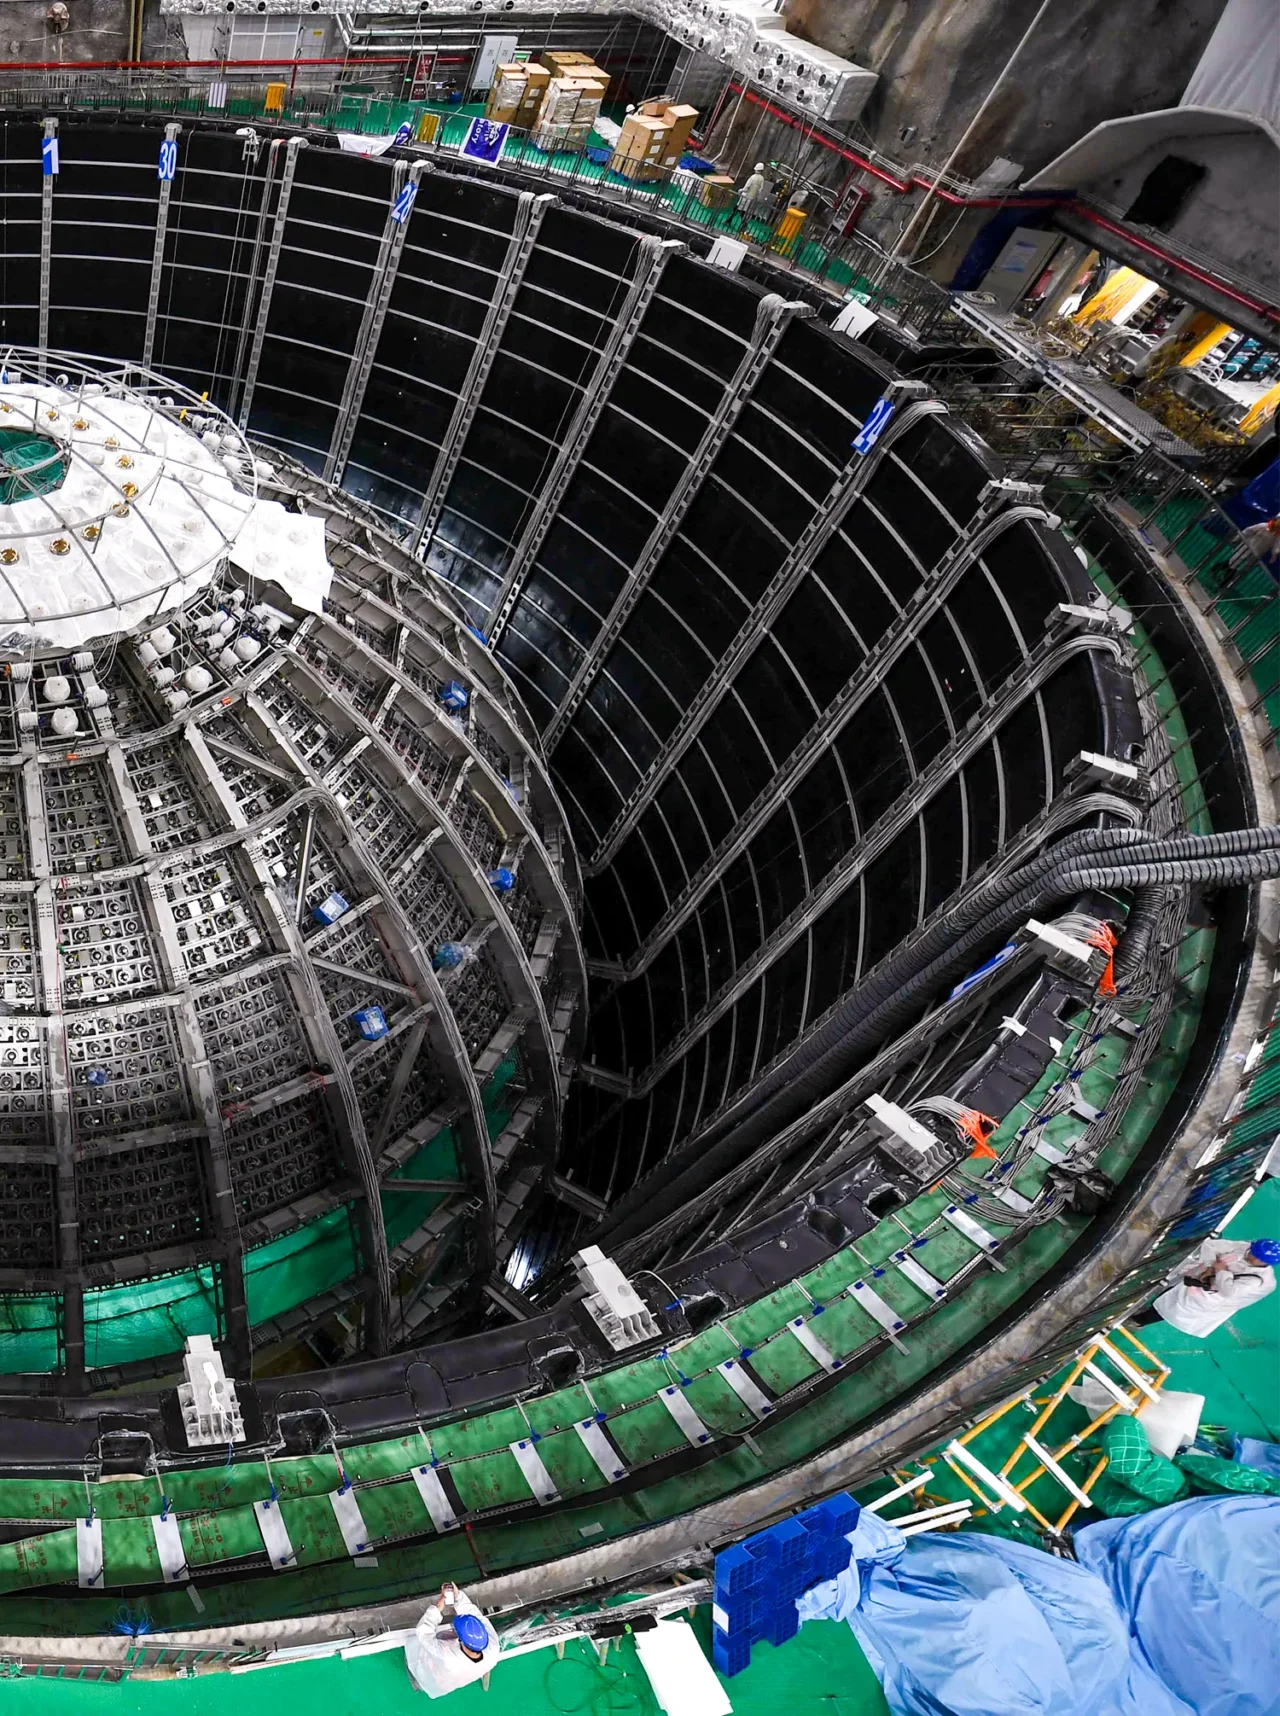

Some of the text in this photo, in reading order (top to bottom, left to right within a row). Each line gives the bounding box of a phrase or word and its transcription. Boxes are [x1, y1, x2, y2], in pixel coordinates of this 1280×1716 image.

[42, 138, 59, 175] 1
[158, 143, 177, 179] 30
[390, 184, 418, 224] 28
[852, 399, 896, 453] 24
